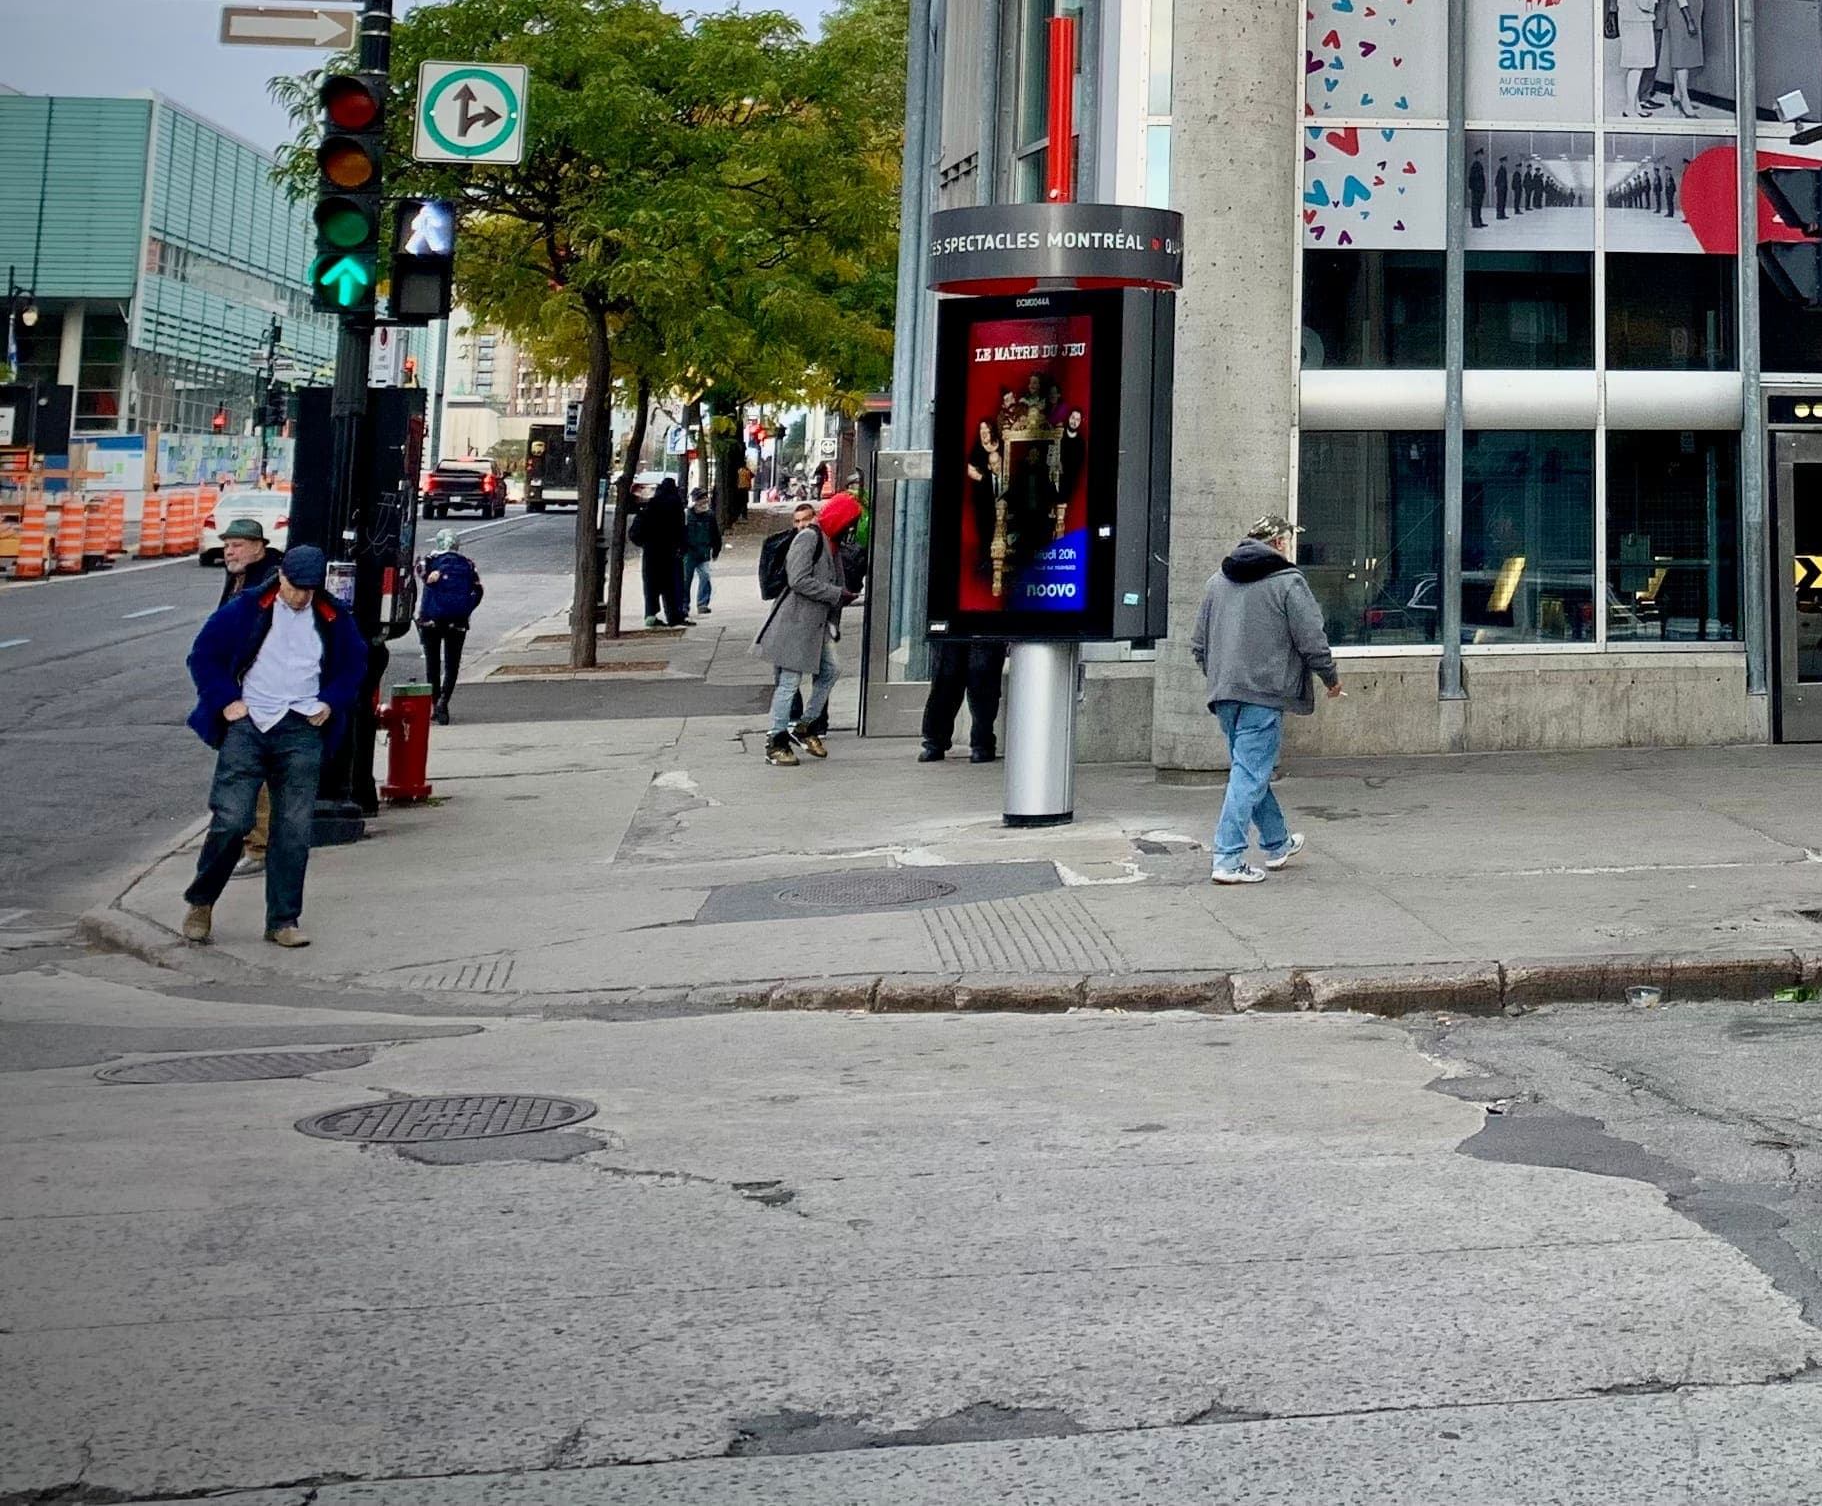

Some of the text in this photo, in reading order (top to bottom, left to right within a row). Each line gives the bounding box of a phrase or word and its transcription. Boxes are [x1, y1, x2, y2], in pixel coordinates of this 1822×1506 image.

[1498, 49, 1556, 71] ans
[1499, 77, 1512, 86] AU
[1544, 77, 1557, 86] DE
[944, 232, 1040, 254] SPECTACLES
[1046, 228, 1145, 251] MONTRÉAL
[975, 342, 1086, 362] LE MAÎTRE DU JEU
[1058, 548, 1077, 560] 20h
[1027, 583, 1076, 598] noovo
